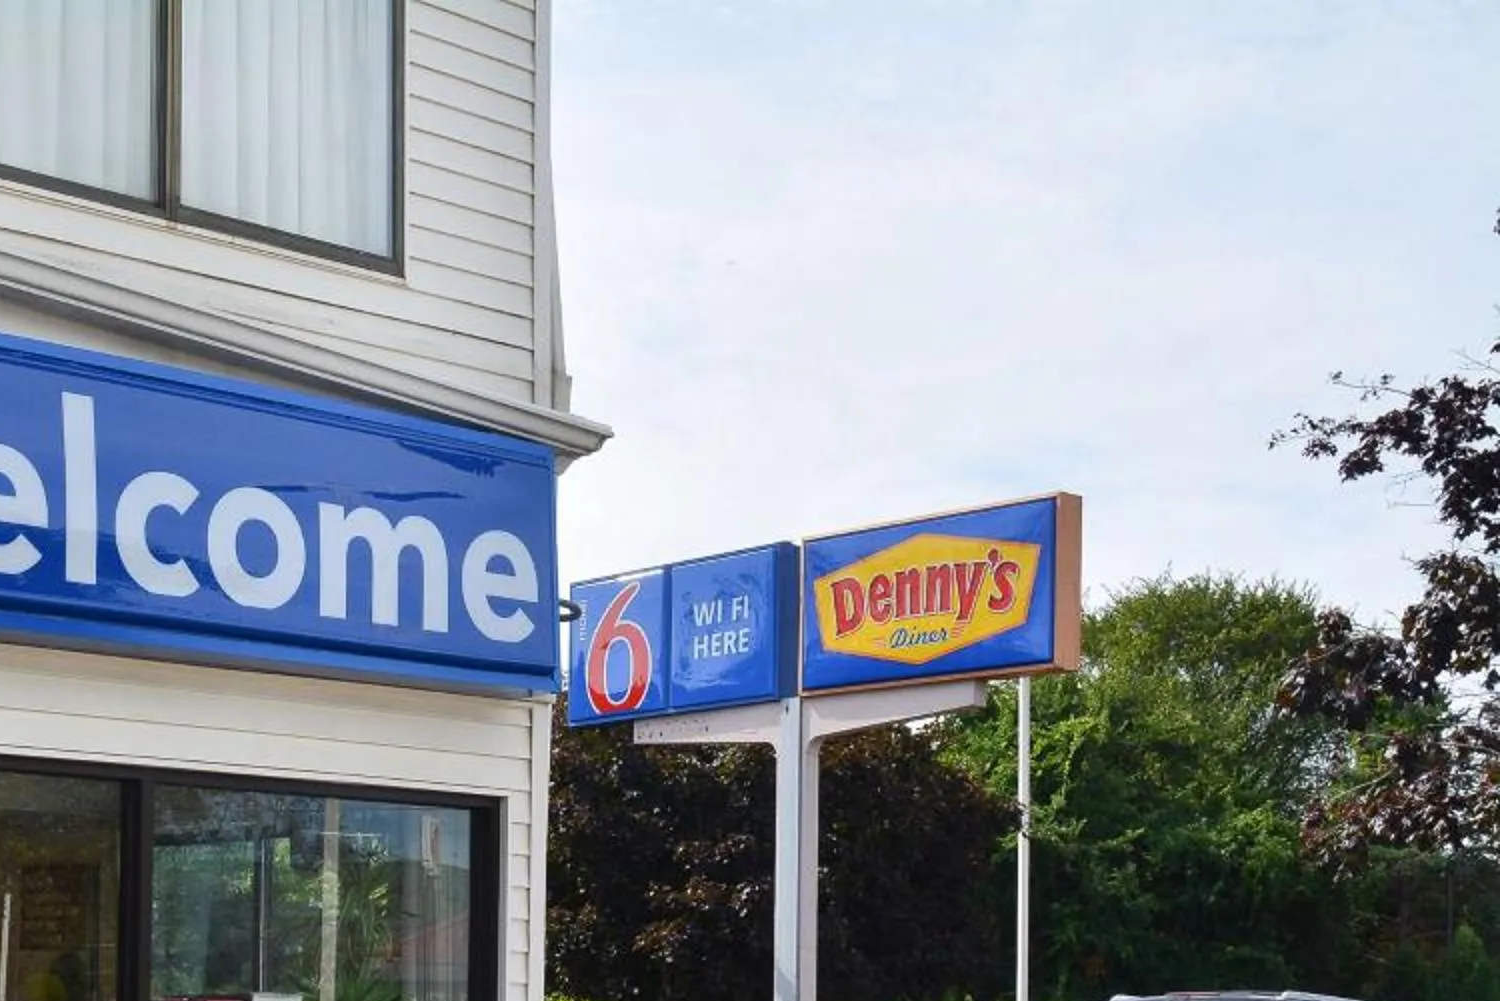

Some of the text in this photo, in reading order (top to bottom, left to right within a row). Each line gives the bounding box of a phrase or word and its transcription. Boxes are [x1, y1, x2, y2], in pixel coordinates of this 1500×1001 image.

[830, 548, 1020, 639] Denny's
[693, 595, 749, 628] WI FI
[586, 581, 652, 716] 6
[694, 627, 751, 660] HERE
[890, 625, 949, 649] Diner
